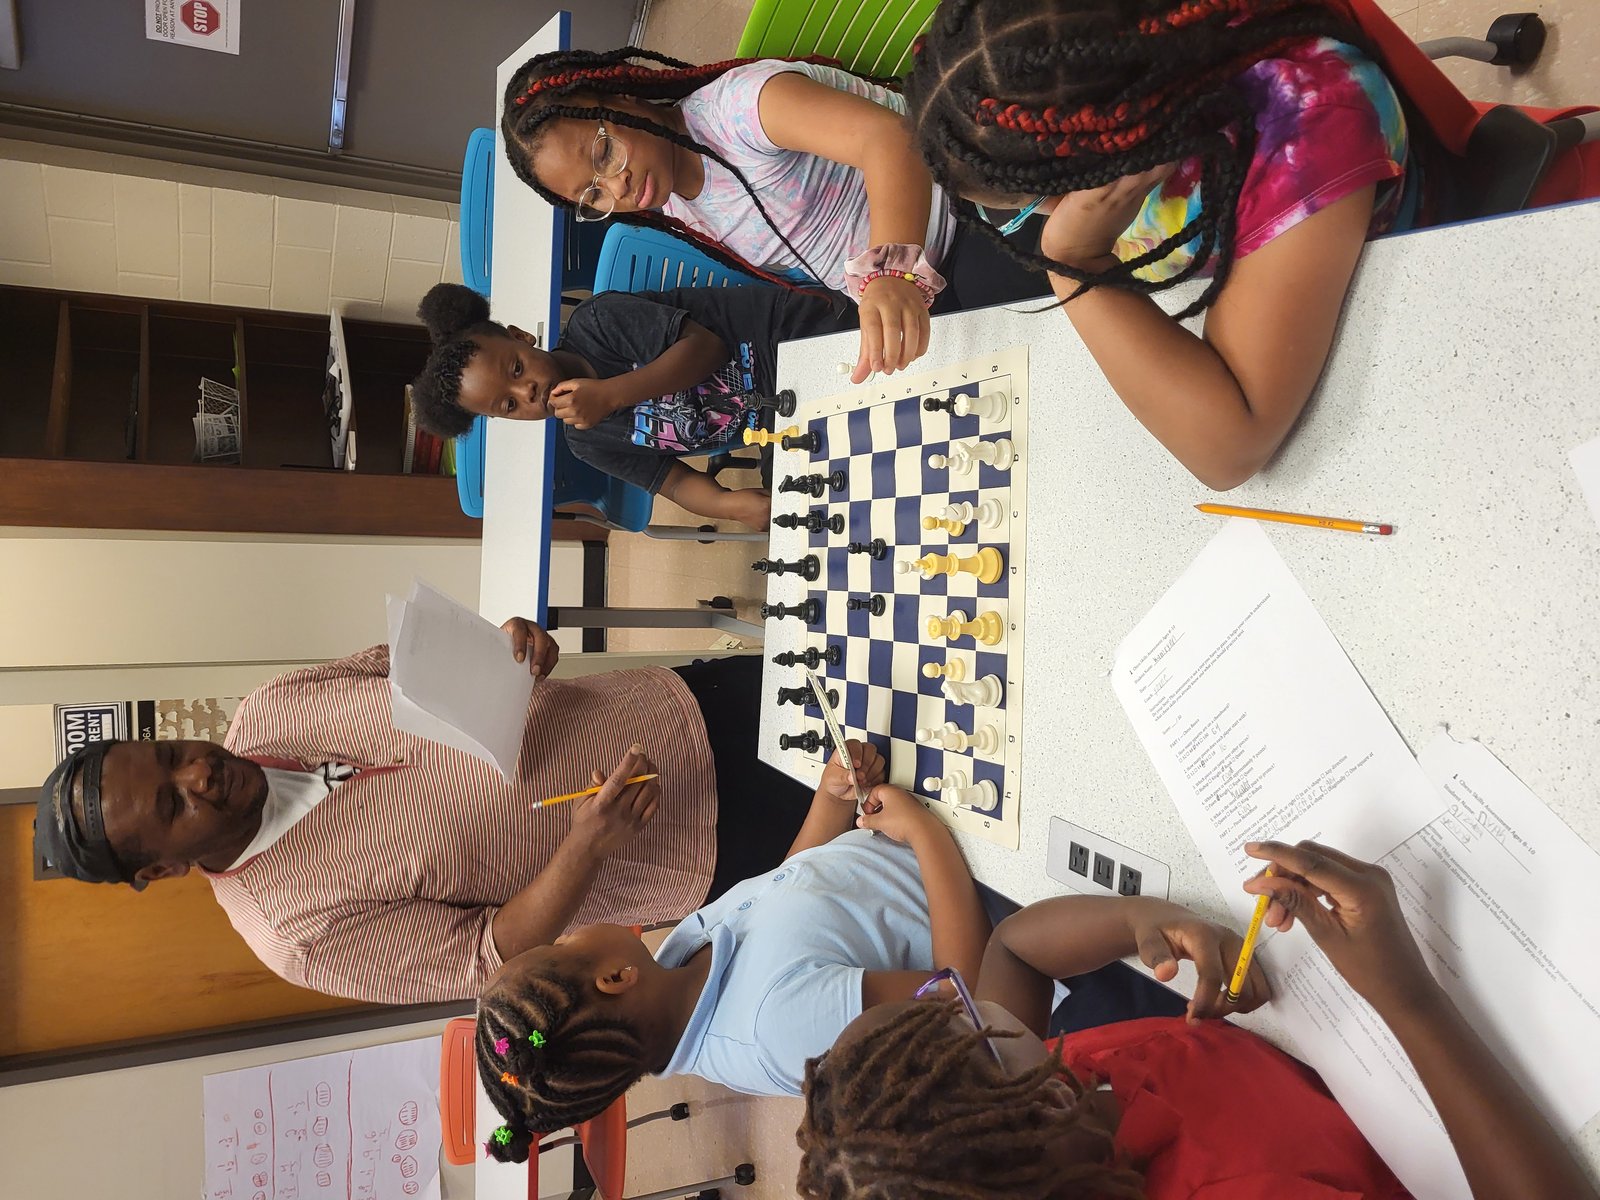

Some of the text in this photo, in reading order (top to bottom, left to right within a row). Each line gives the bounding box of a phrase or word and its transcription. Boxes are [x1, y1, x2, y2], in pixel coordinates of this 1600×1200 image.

[194, 2, 208, 32] STOP
[66, 714, 86, 754] OOM
[88, 712, 100, 742] RENT
